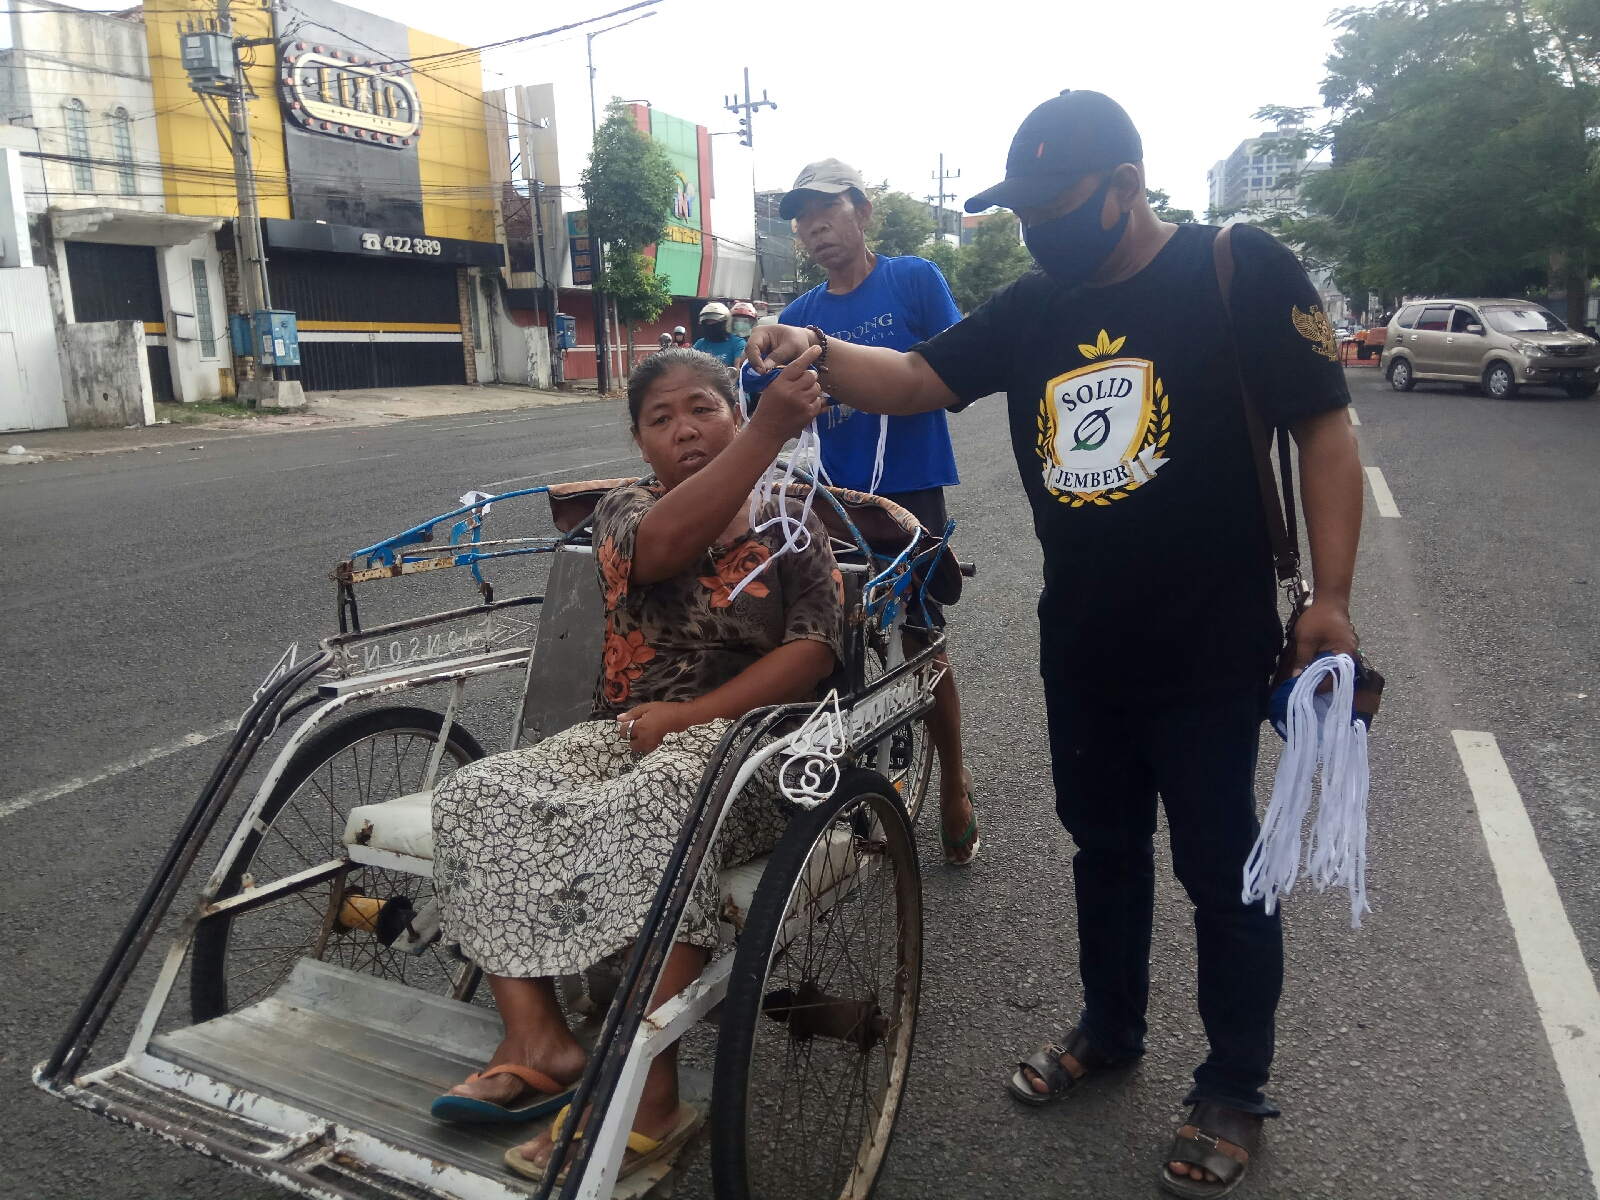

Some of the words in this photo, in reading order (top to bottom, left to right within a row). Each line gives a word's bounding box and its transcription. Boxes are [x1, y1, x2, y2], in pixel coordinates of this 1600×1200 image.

[384, 235, 412, 253] 422
[414, 238, 441, 255] 889
[831, 312, 893, 342] DONG
[1061, 377, 1133, 412] SOLID
[1055, 464, 1131, 489] JEMBER
[800, 759, 825, 792] S
